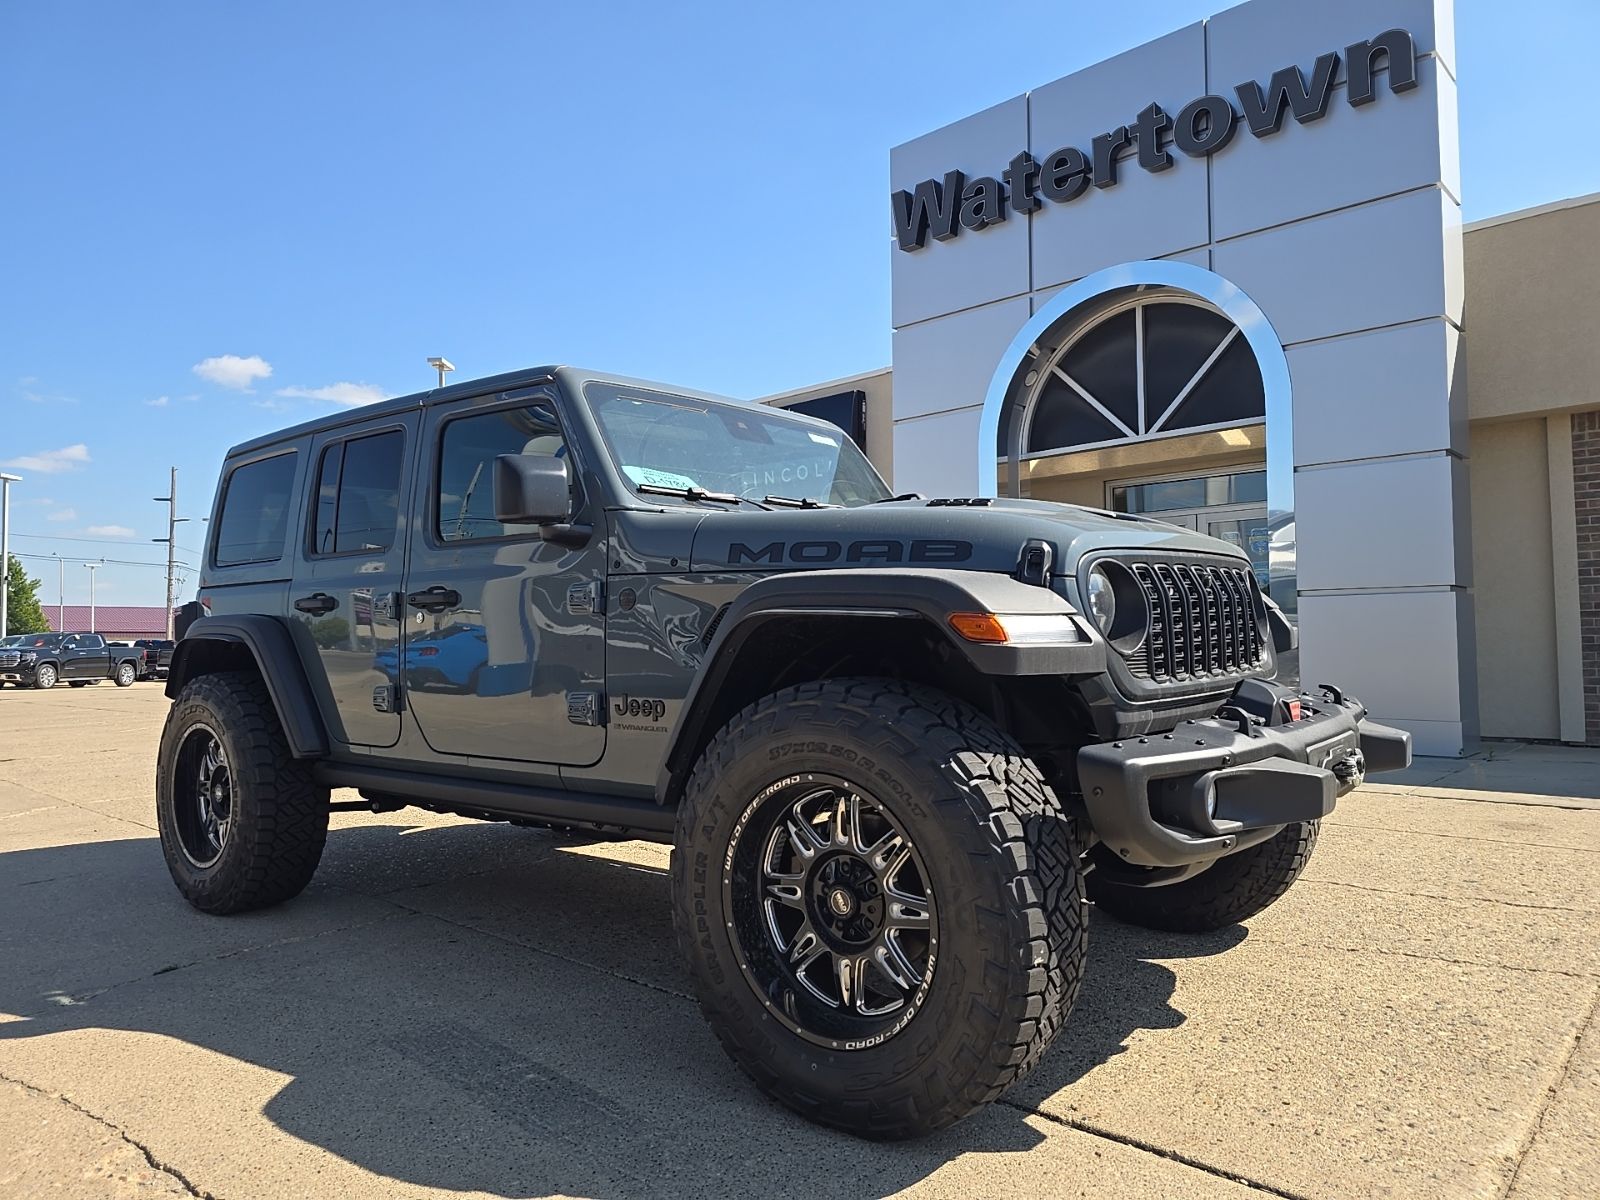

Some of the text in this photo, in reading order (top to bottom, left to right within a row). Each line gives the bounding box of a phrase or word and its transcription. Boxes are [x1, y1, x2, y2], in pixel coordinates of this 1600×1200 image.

[891, 28, 1417, 252] Watertown
[744, 460, 832, 486] INCOL
[728, 540, 973, 564] MOAB
[614, 693, 666, 721] Jeep
[620, 723, 668, 733] WRANGLER
[724, 775, 801, 871] WELD OFF-ROAD
[845, 954, 936, 1050] WELD OFF-ROAD
